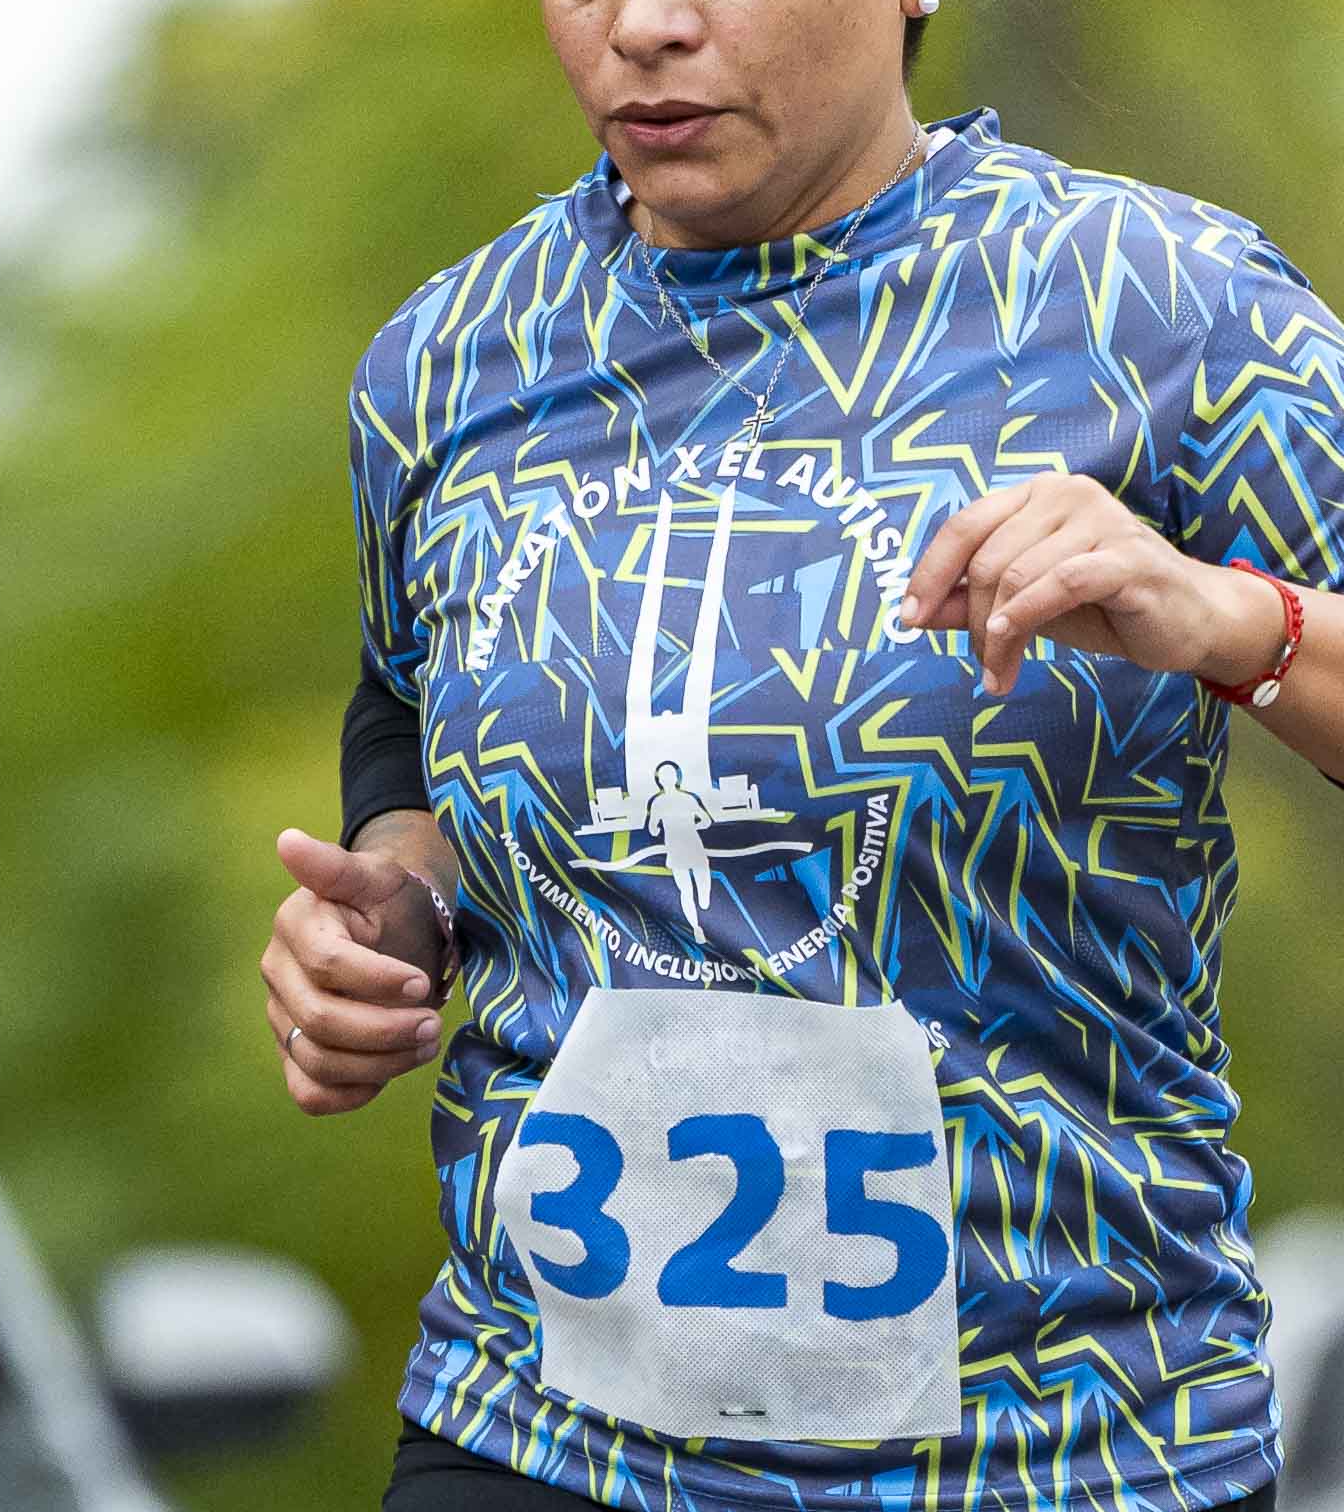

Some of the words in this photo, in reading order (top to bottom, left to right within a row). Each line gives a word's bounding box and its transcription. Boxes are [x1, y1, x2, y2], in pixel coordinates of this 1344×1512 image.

[465, 456, 651, 672] MARATÓN
[667, 444, 706, 482] X
[716, 441, 767, 481] EL
[776, 453, 924, 645] AUTISMO
[499, 831, 622, 959] MOVIMIENTO,
[842, 792, 889, 901] POSITIVA
[518, 1111, 950, 1322] 325
